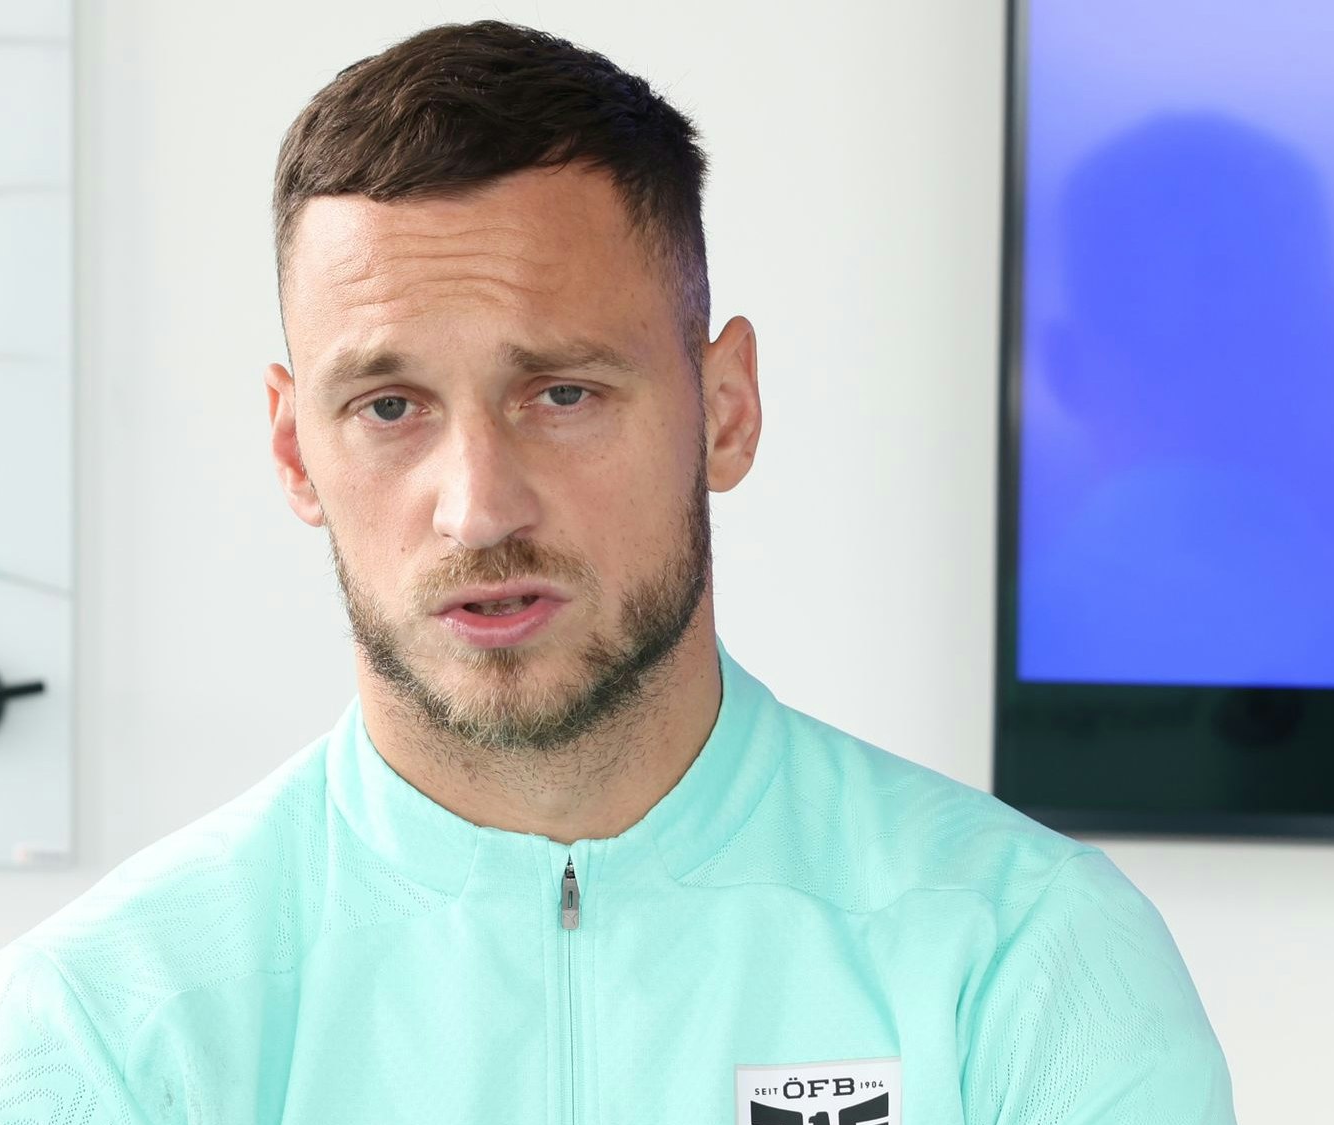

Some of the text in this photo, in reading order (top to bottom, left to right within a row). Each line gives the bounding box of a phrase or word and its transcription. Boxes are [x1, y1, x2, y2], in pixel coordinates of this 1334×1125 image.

[754, 1077, 884, 1099] SEIT ÖFB 1904
